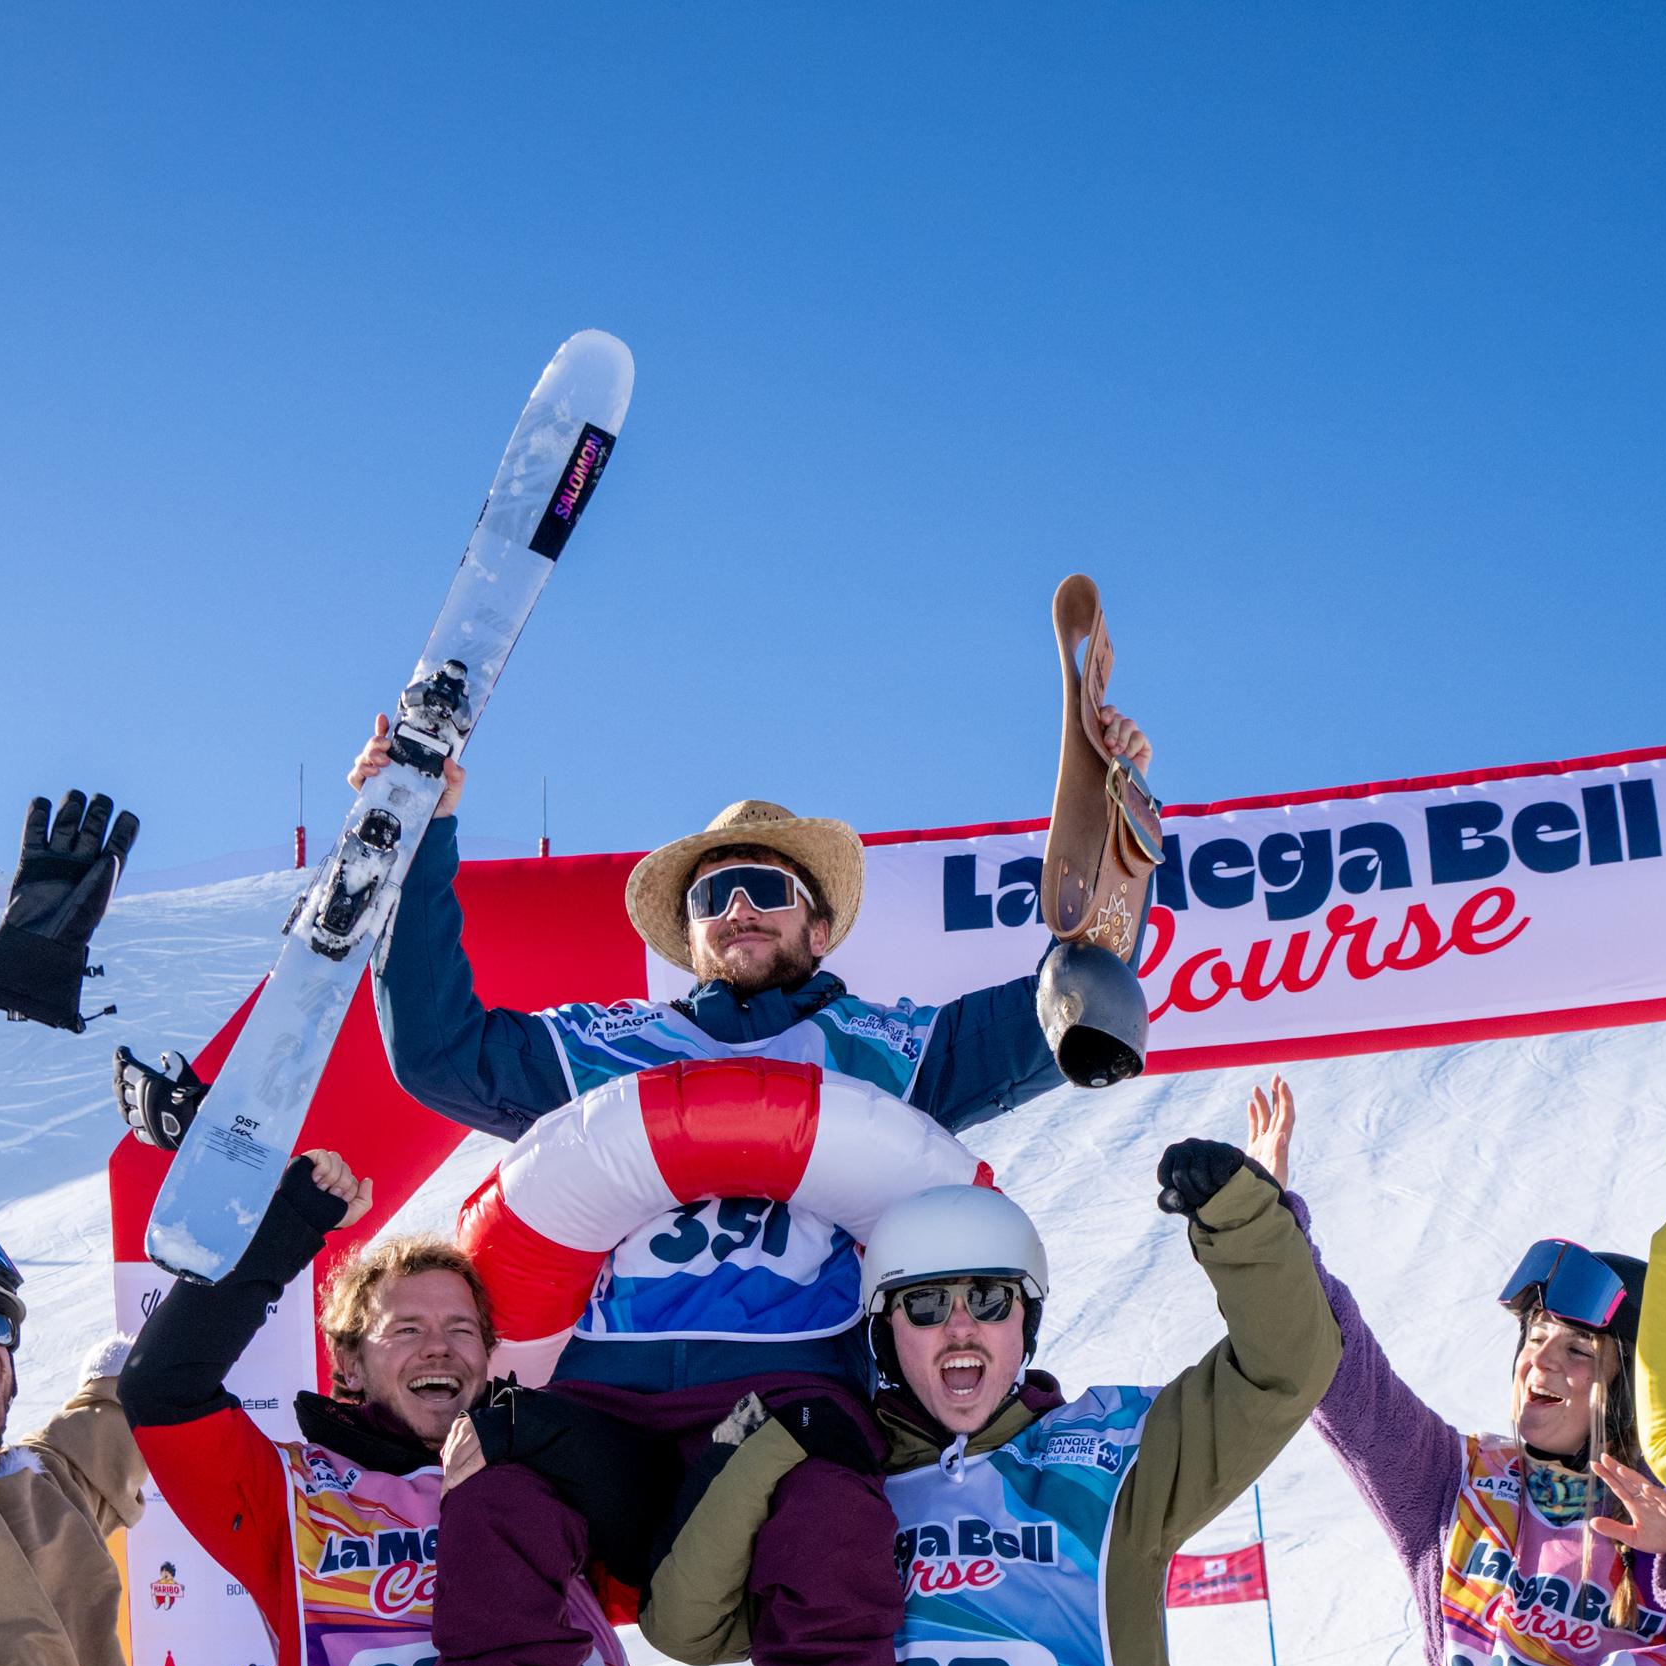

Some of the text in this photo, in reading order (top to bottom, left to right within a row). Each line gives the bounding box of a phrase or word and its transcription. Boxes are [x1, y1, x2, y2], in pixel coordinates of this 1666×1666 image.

[554, 432, 603, 520] SALOMON
[943, 778, 1664, 932] La ega Bell
[605, 1011, 664, 1031] PLAGNE
[235, 1114, 261, 1131] QST
[242, 1398, 279, 1410] ÉBÉ
[1046, 1446, 1095, 1455] PULAIRE
[1048, 1437, 1097, 1446] BANQUE
[1064, 1455, 1094, 1465] ALPES
[314, 1469, 358, 1491] LANE
[1476, 1478, 1494, 1490] LA
[958, 1519, 1054, 1563] Bell
[318, 1532, 371, 1575] La
[1467, 1542, 1512, 1581] La
[904, 1556, 1002, 1595] rse
[153, 1584, 180, 1595] HARIBO
